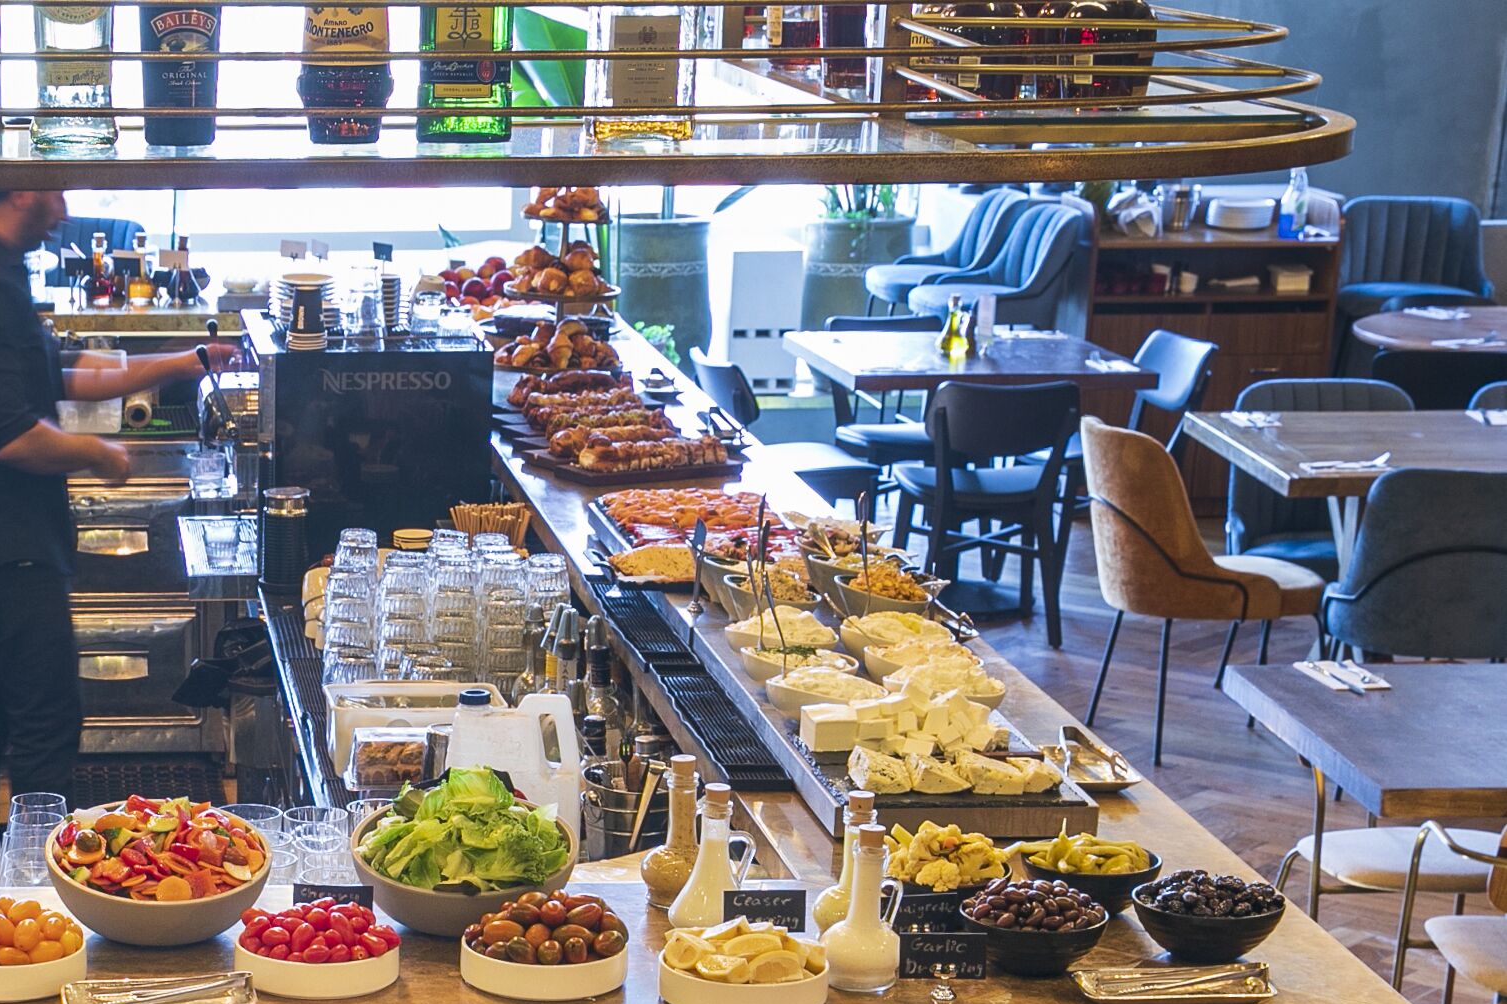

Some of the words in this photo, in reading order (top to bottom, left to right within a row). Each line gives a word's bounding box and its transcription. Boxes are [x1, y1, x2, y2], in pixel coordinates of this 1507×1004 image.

[155, 13, 213, 31] BAILEYS
[305, 17, 374, 38] MONTENEGRO
[319, 369, 452, 394] NESPRESSO
[911, 937, 967, 953] Garlic
